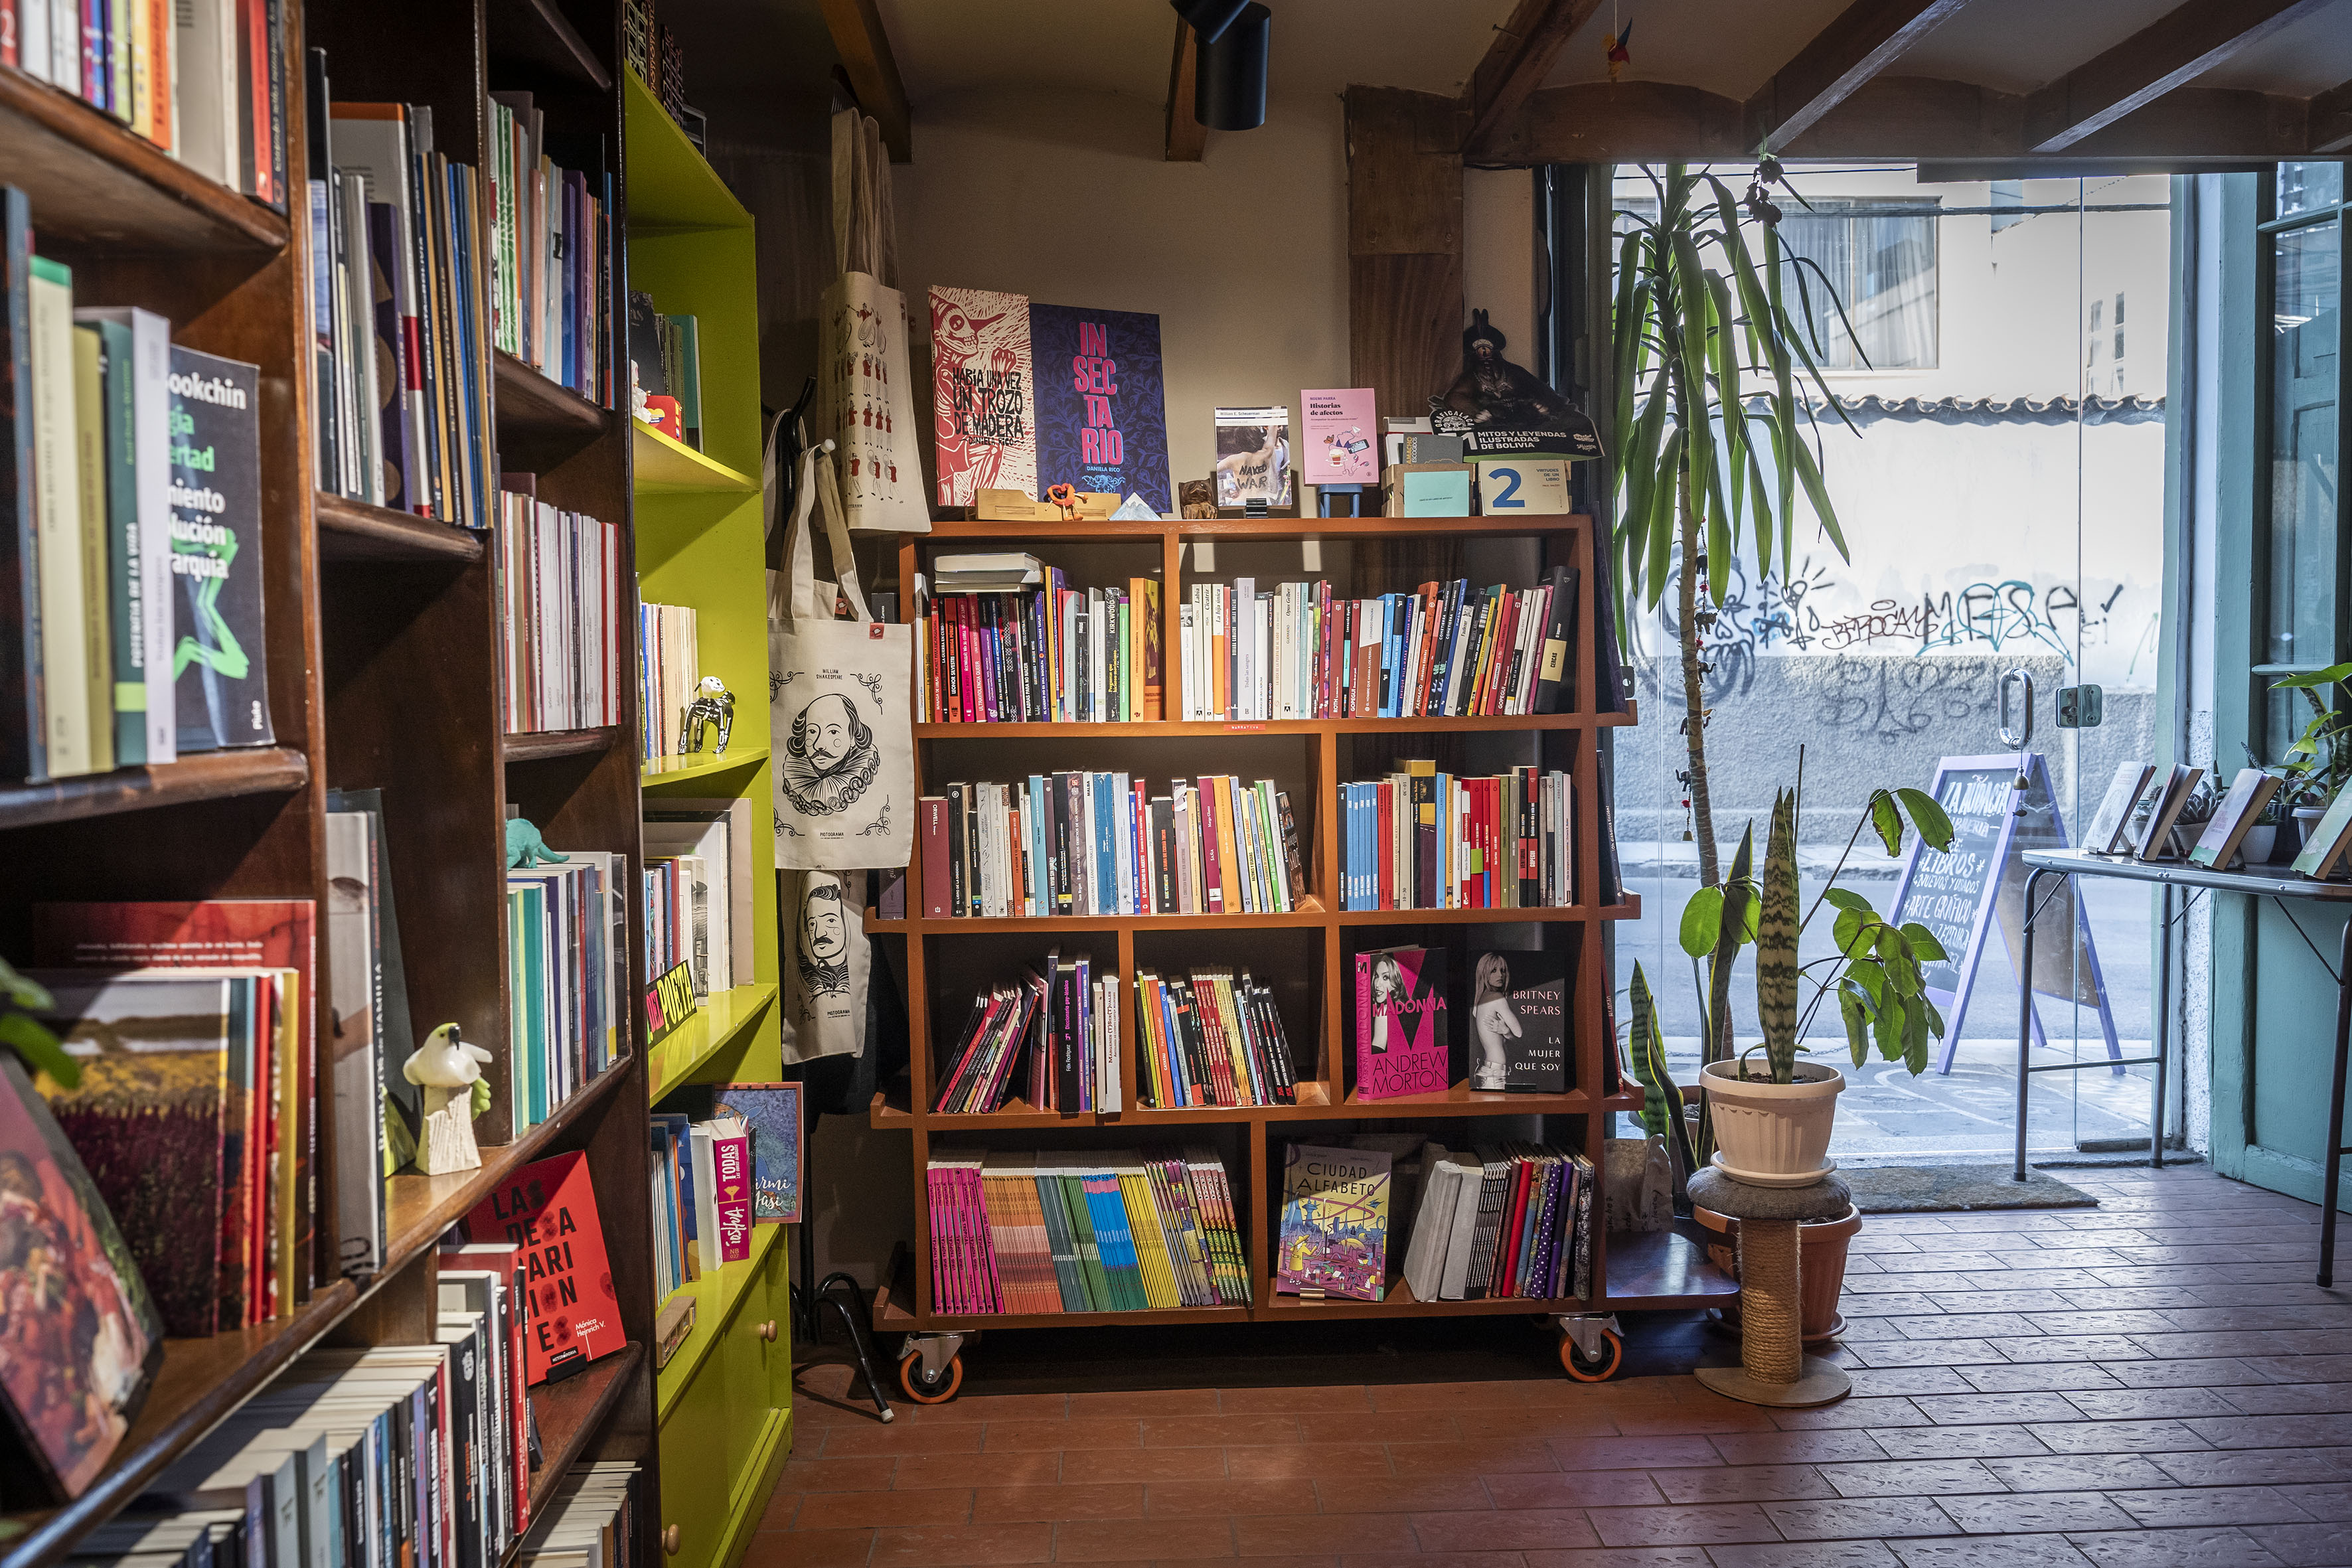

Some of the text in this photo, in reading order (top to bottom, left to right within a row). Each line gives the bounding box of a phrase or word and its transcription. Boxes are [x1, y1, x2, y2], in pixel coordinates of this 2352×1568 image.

[1079, 322, 1107, 357] IN
[986, 370, 1003, 388] UNA
[1004, 372, 1022, 390] VEZ
[1073, 356, 1117, 395] SEC
[953, 387, 1023, 414] UN TROZO
[1083, 394, 1113, 428] TA
[954, 412, 1024, 438] DE MADERA
[1081, 428, 1123, 465] RIO
[1239, 463, 1267, 476] NAKED
[1237, 476, 1267, 489] WAR
[1488, 468, 1525, 507] 2
[169, 514, 227, 546] lución
[1922, 852, 1976, 878] LIBROS
[1916, 874, 1949, 890] NUEVOS
[1909, 894, 1972, 924] ARTE GRÁFICO
[1357, 961, 1368, 974] M
[656, 969, 695, 1032] POETA
[1372, 996, 1447, 1018] MADONNA
[1513, 990, 1561, 1000] BRITNEY
[1520, 1005, 1561, 1015] SPEARS
[1372, 1050, 1448, 1076] ANDREW
[1528, 1049, 1561, 1058] MUJER
[1515, 1062, 1560, 1071] QUE SOY
[1372, 1068, 1448, 1095] MORTON
[721, 1144, 736, 1182] TODAS
[1307, 1162, 1367, 1179] CIUDAD
[1297, 1178, 1375, 1196] ALFABETO
[576, 1318, 597, 1330] Mónica
[577, 1324, 599, 1338] Heinrich
